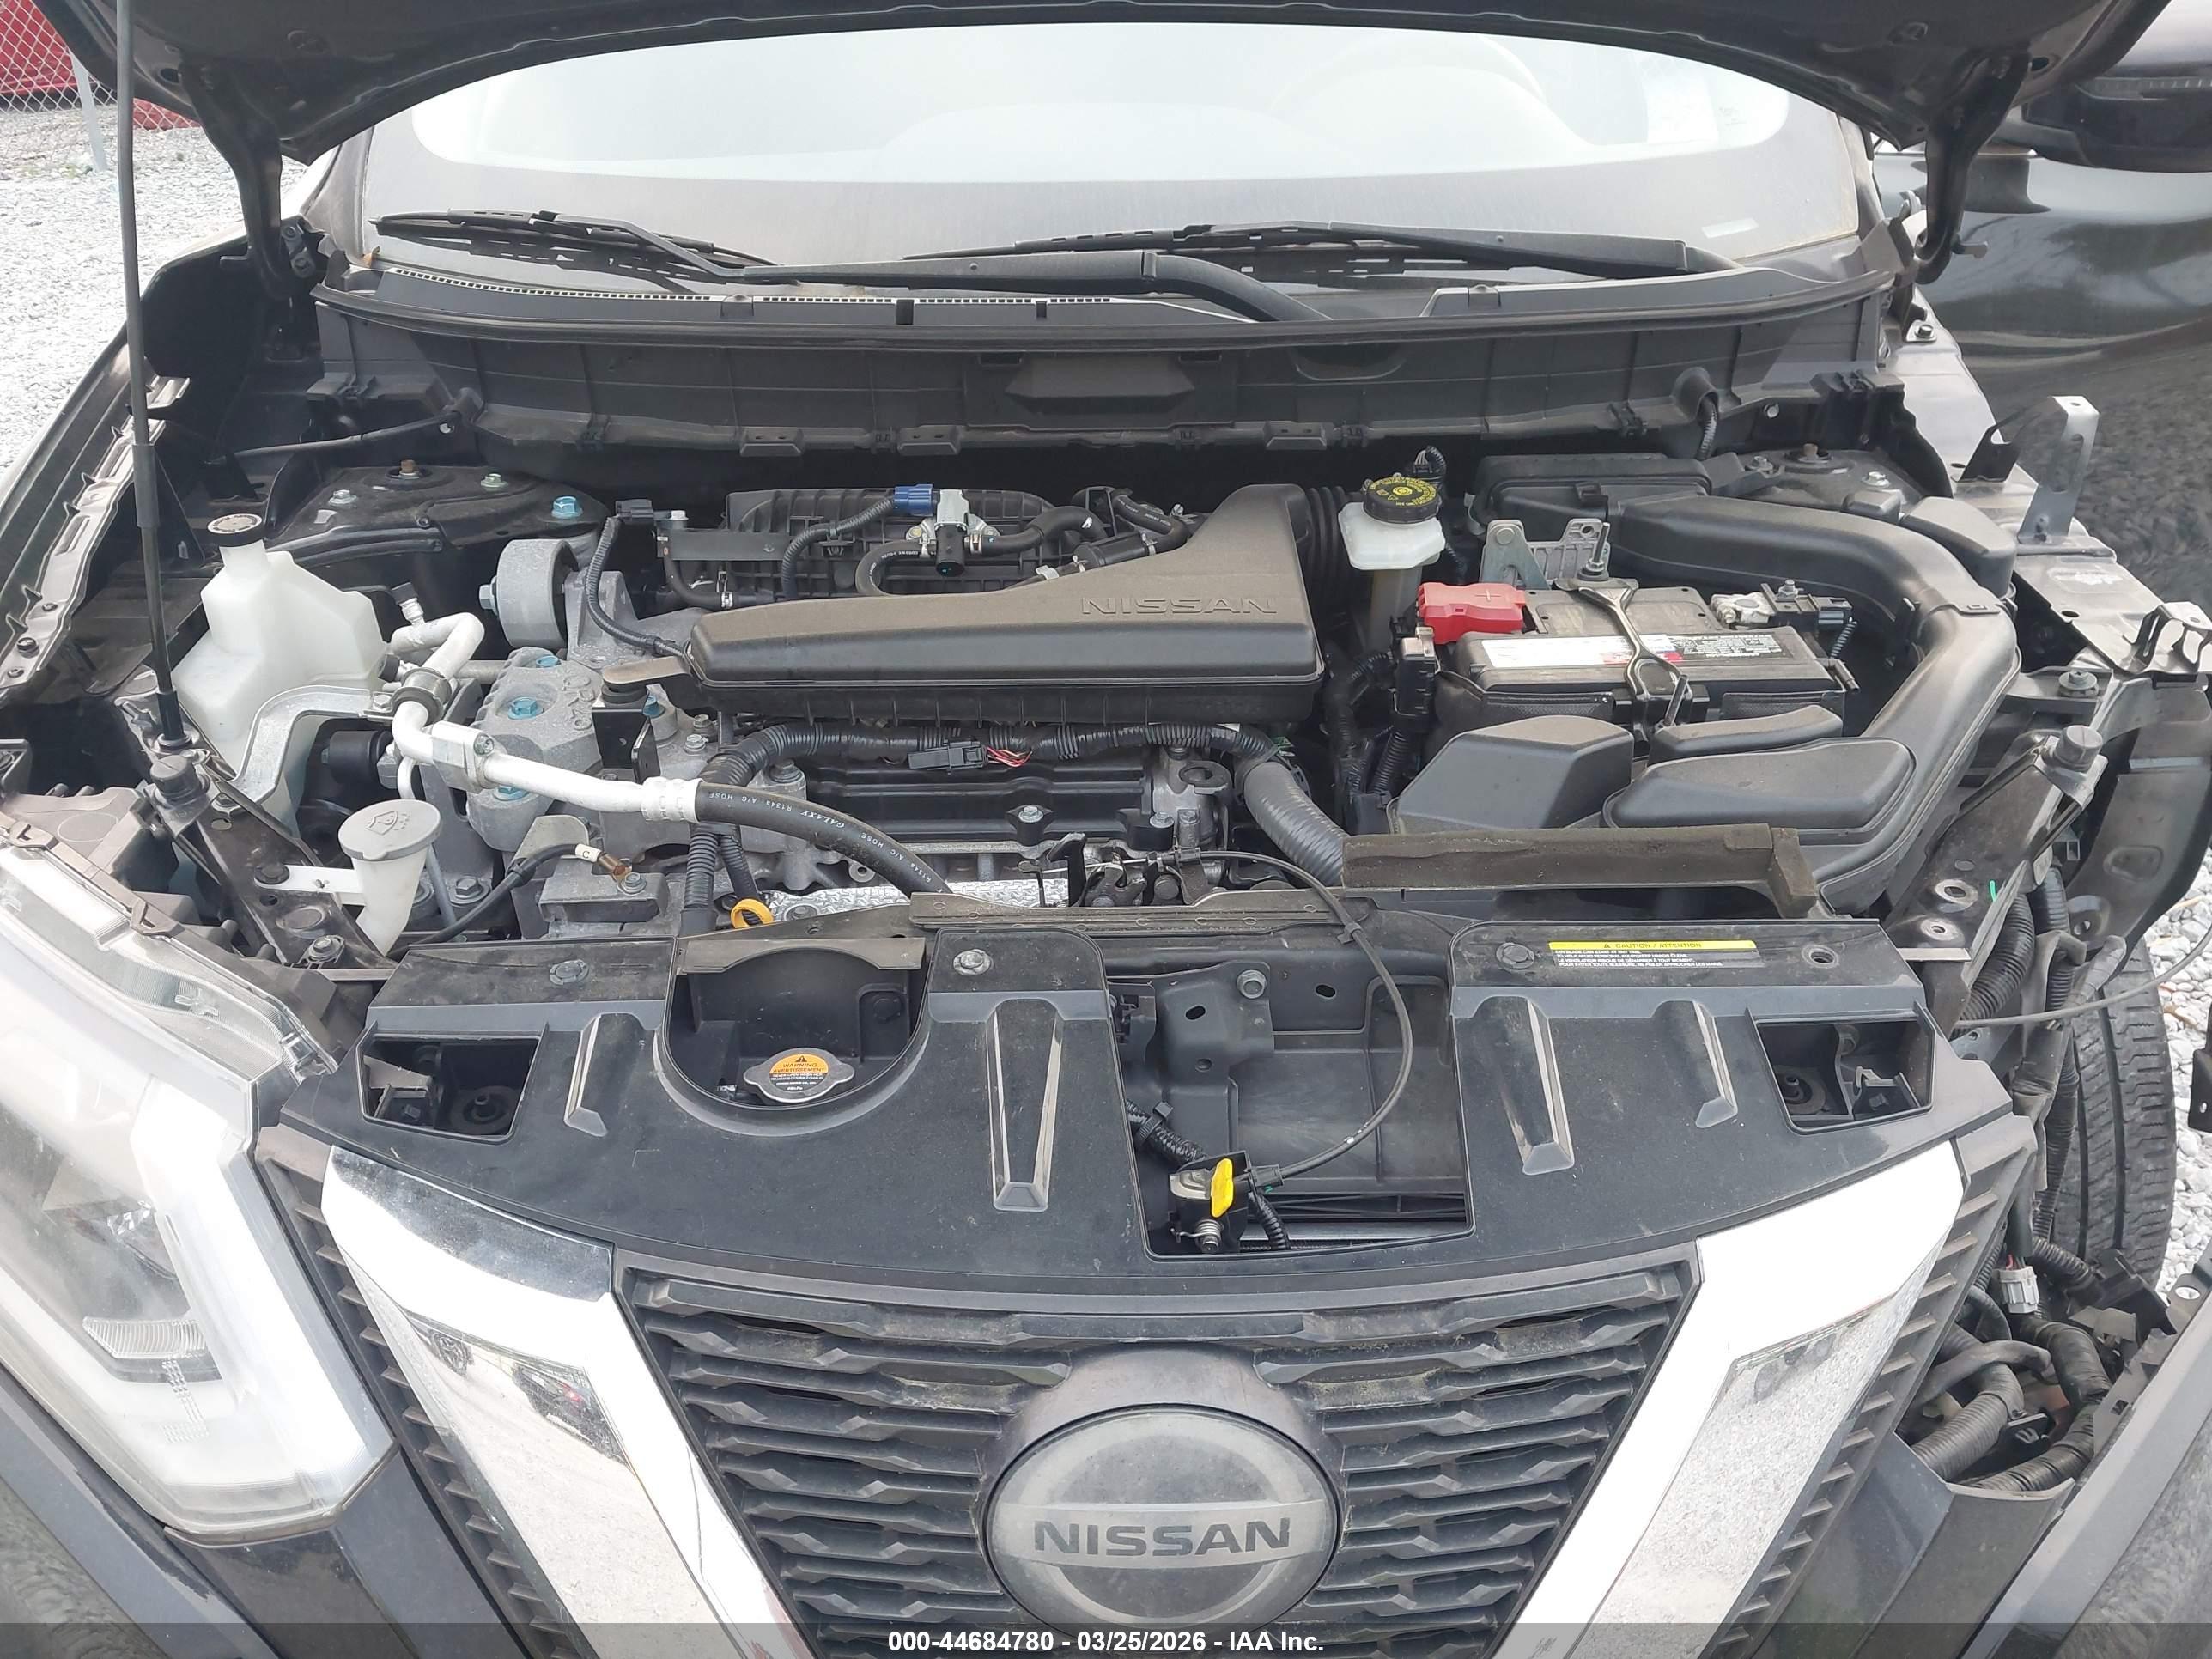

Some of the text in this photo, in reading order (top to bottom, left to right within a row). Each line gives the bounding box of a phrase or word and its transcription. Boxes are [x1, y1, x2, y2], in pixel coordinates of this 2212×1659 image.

[1081, 597, 1278, 615] NISSAN
[708, 792, 733, 800] HOSE
[741, 795, 757, 804] A/C
[799, 810, 846, 829] GALAXY
[860, 831, 884, 848] HOSE
[582, 850, 591, 859] C
[1034, 1516, 1291, 1557] NISSAN
